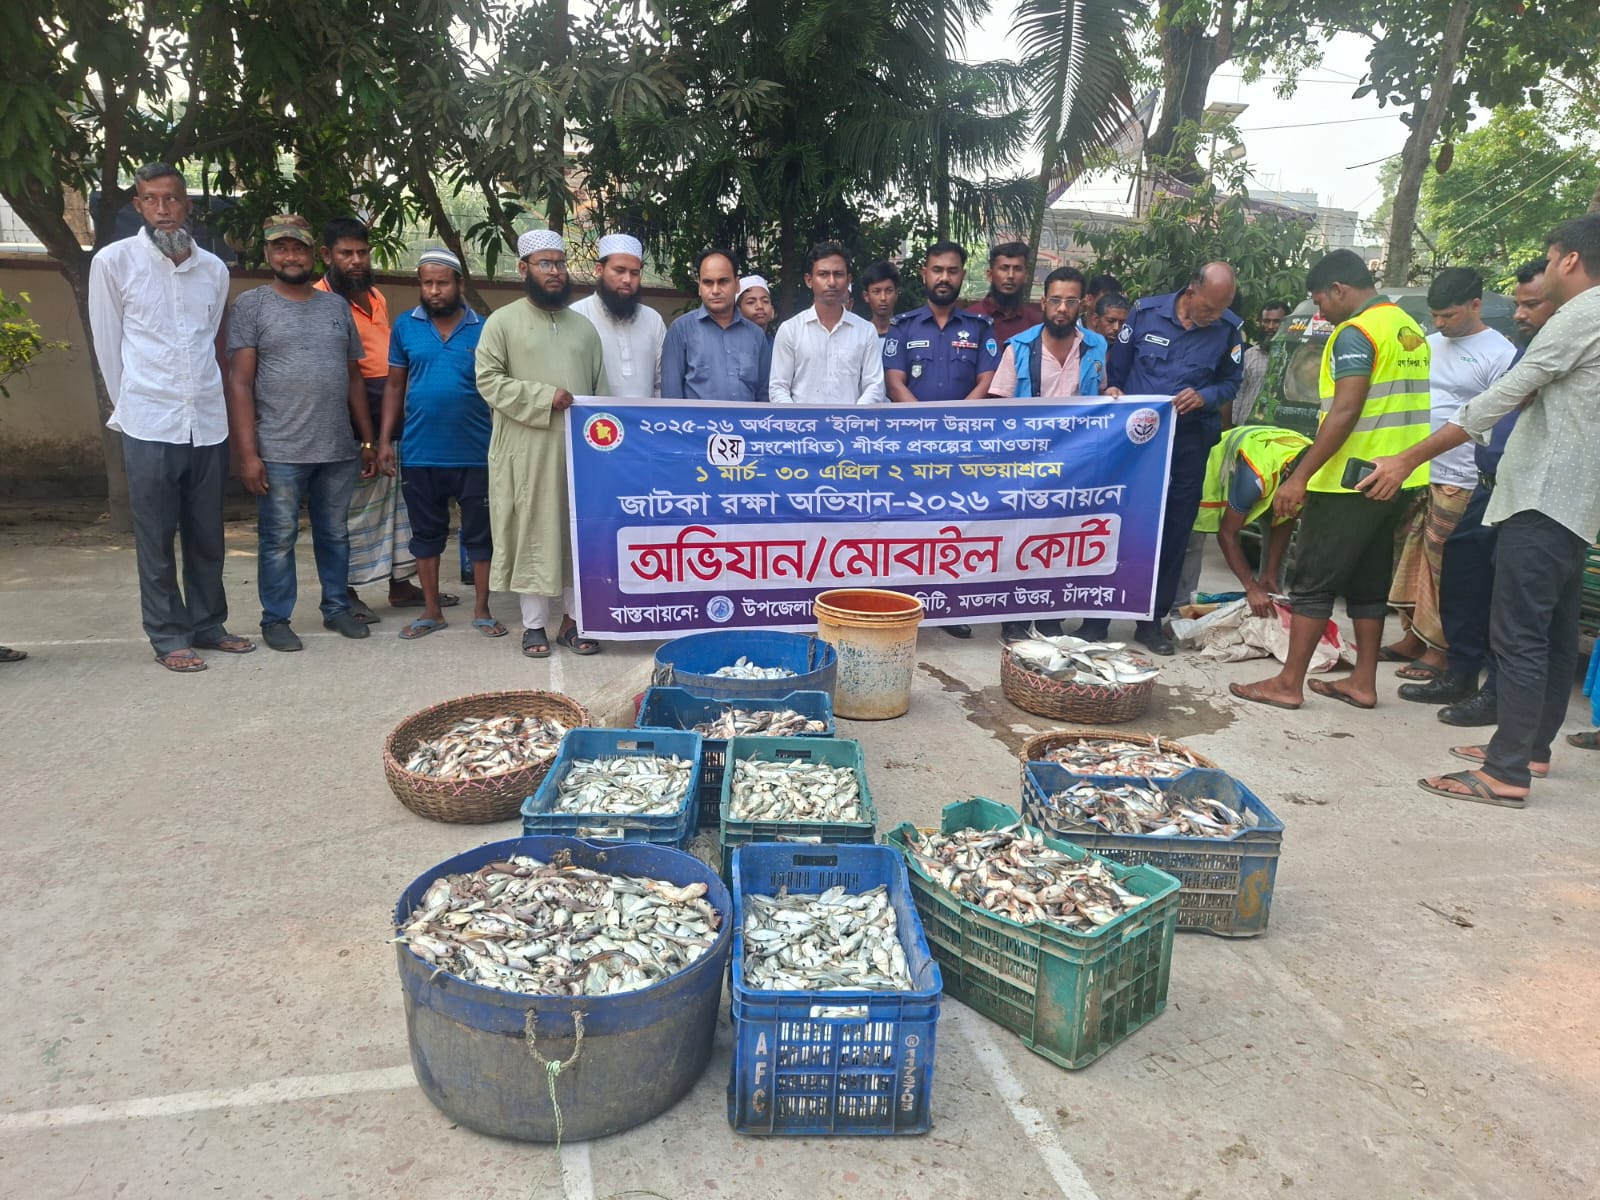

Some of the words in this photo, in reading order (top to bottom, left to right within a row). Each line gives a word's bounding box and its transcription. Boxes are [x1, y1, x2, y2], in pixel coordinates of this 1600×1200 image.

[640, 418, 734, 435] ২০২৫-২৬
[740, 414, 818, 433] অর্থবছরে
[886, 417, 938, 433] সম্পদ
[943, 414, 996, 432] উন্নয়ন
[1002, 417, 1017, 431] ও
[708, 434, 742, 464] (২য়
[750, 439, 845, 457] সংশোধিত)
[852, 436, 900, 455] শীর্ষক
[906, 438, 972, 454] প্রকল্পের
[978, 437, 1052, 453] আওতায়
[696, 466, 709, 482] ১
[775, 466, 809, 480] ৩০
[819, 460, 880, 481] এপ্রিল
[888, 464, 905, 482] ২
[912, 463, 952, 480] মাস
[959, 461, 1065, 480] অভয়াশ্রমে
[617, 487, 712, 517] জাটকা
[720, 490, 780, 515] রক্ষা
[787, 485, 990, 515] অভিযান-২০২৬
[998, 484, 1127, 512] বাস্তবায়নে
[628, 525, 1003, 583] অভিযান/মোবাইল
[1015, 518, 1111, 572] কোর্ট
[609, 604, 699, 625] বাস্তবায়নে:
[741, 596, 815, 618] উপজেলা
[914, 590, 952, 614] মিটি,
[958, 592, 1010, 610] মতলব
[1014, 586, 1056, 609] উত্তর,
[1062, 582, 1116, 606] চাঁদপুর
